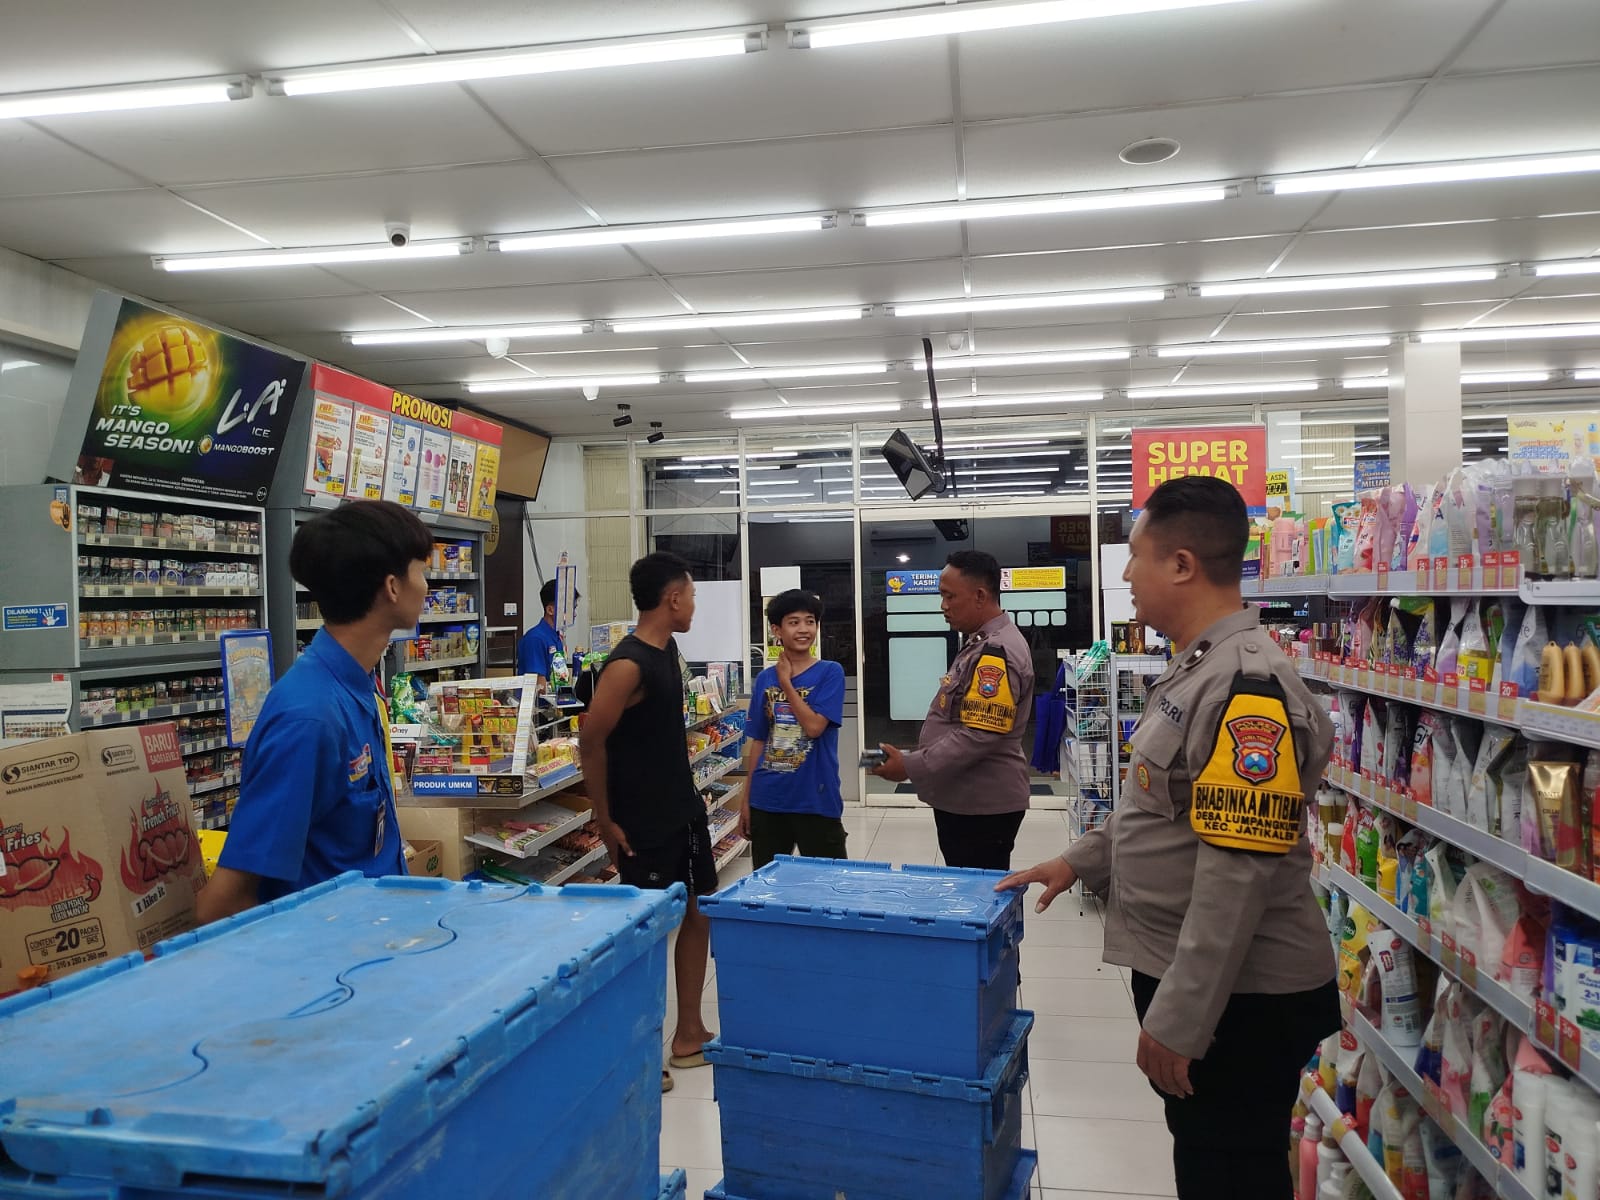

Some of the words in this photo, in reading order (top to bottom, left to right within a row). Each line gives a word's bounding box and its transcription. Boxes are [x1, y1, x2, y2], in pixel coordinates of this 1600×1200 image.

[111, 405, 141, 416] IT'S
[391, 391, 453, 430] PROMOSI
[96, 418, 170, 435] MANGO
[252, 426, 271, 438] ICE
[104, 434, 195, 454] SEASON!
[213, 443, 275, 456] MANGOBOOST
[1148, 440, 1249, 465] SUPER
[1159, 697, 1183, 723] POLRI
[144, 732, 177, 754] BARU!
[21, 760, 56, 774] SIANTAR
[58, 756, 75, 765] TOP
[413, 781, 446, 789] PRODUK
[448, 781, 473, 789] UMKM
[1196, 811, 1221, 820] DESA
[1205, 821, 1231, 832] KEC.
[6, 832, 41, 852] Fries
[136, 902, 142, 913] I
[142, 892, 159, 909] like
[158, 886, 166, 898] it
[80, 925, 99, 936] PACKS
[55, 928, 80, 953] 20
